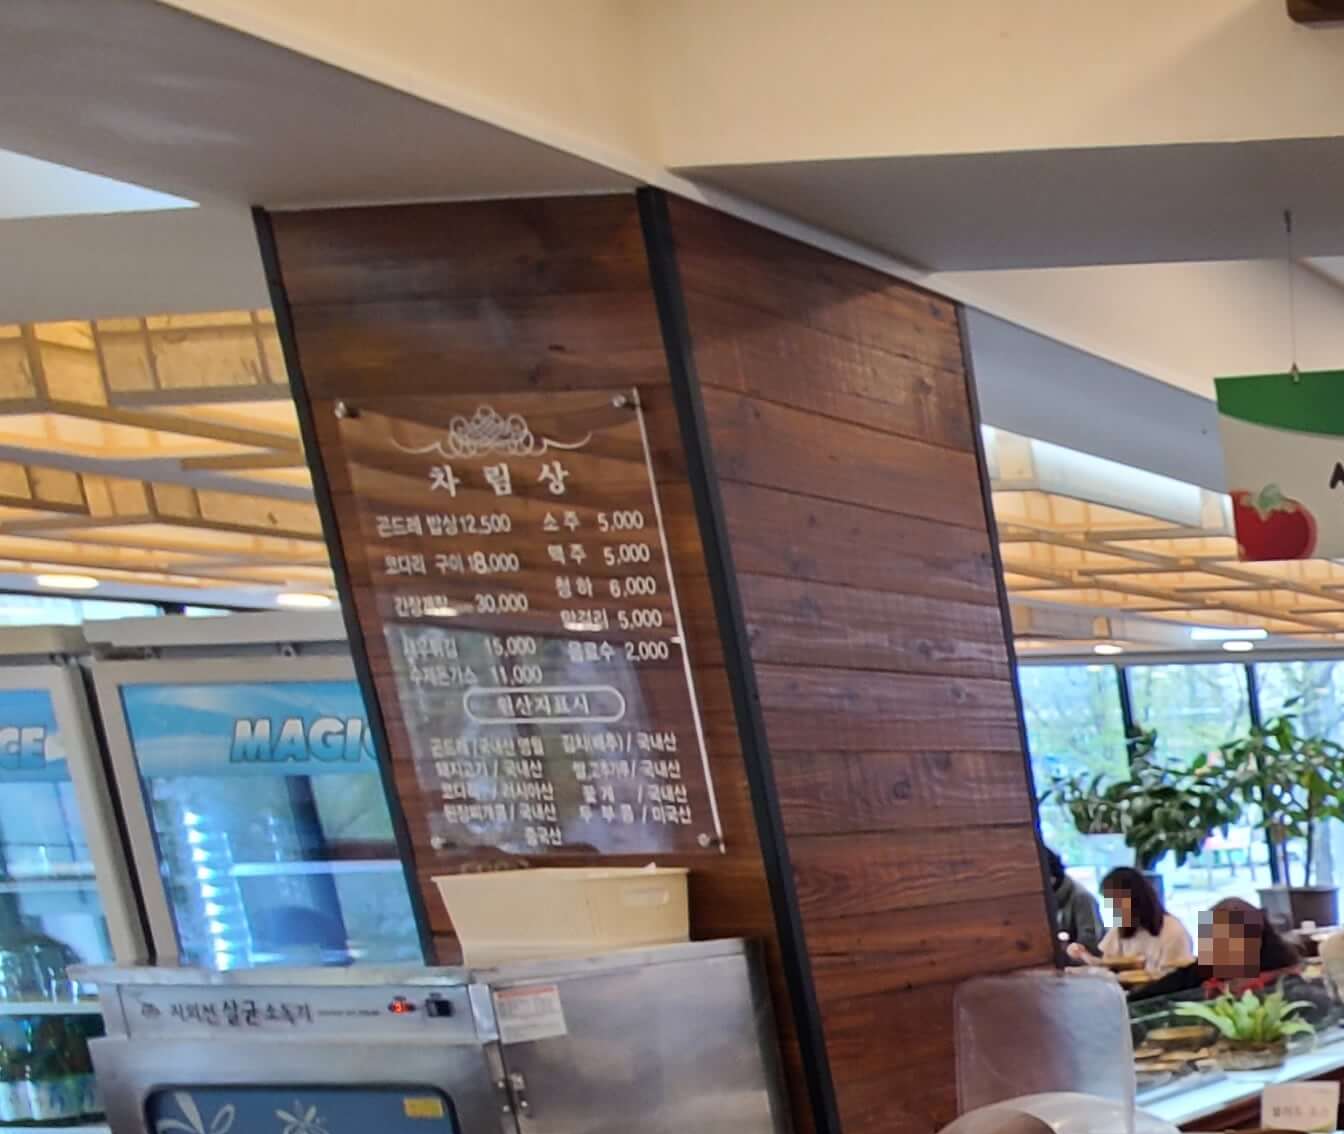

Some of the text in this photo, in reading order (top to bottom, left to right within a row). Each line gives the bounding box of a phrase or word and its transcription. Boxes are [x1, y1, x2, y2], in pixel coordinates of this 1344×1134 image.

[598, 510, 644, 532] 5,000
[435, 553, 464, 575] 구이
[604, 543, 650, 566] 5,000
[609, 576, 656, 598] 6,000
[618, 608, 662, 631] 5,000
[625, 640, 669, 661] 2,000
[499, 694, 589, 716] 원산지표시
[503, 760, 543, 779] 국내산
[519, 802, 558, 822] 국내산
